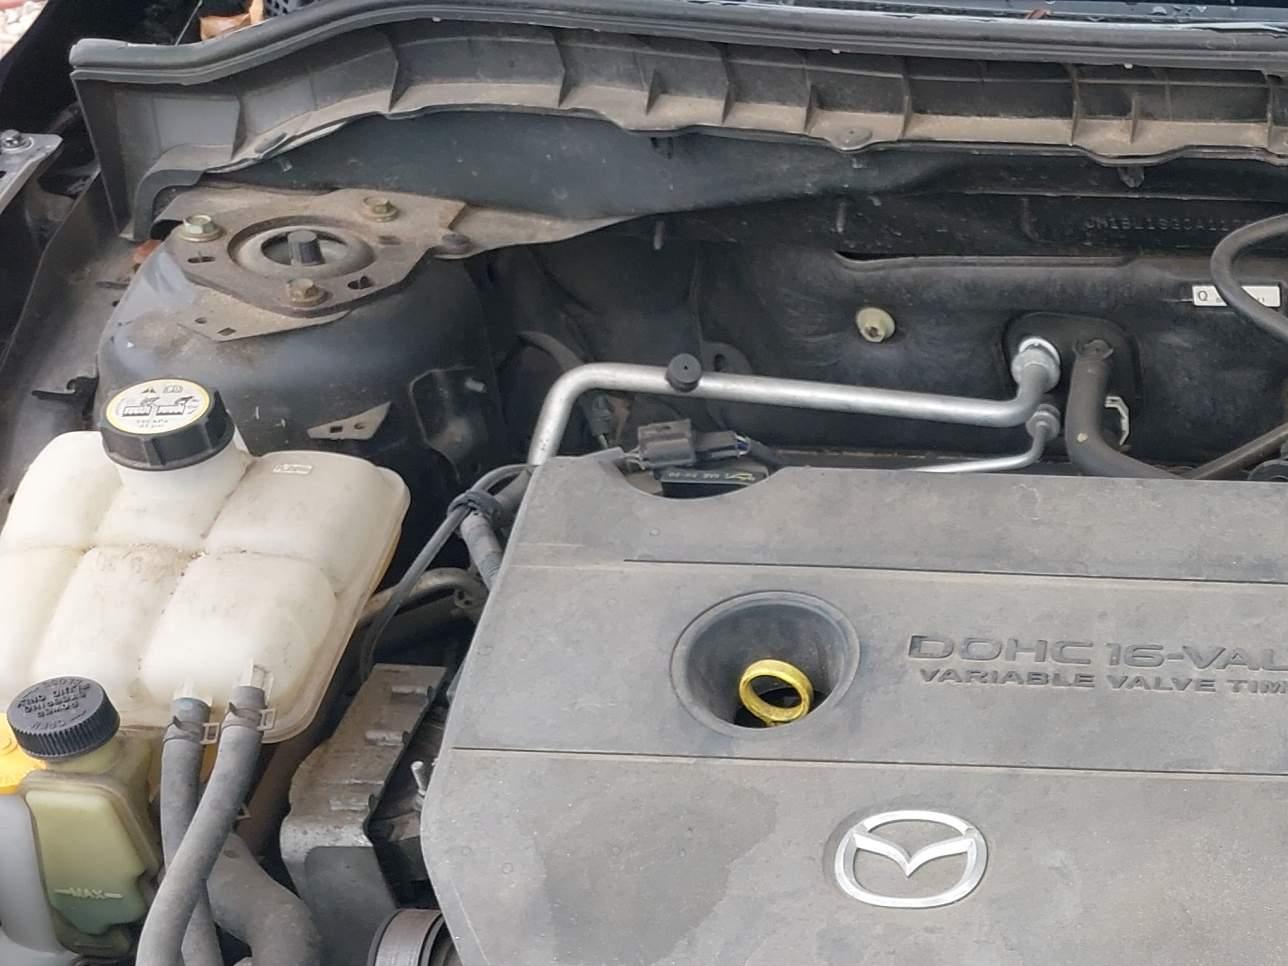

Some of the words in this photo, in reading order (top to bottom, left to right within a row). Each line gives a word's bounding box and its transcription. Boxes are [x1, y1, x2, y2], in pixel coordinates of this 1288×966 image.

[908, 634, 1094, 665] DOHC
[920, 668, 1096, 689] VARIABLE
[1107, 674, 1217, 693] VALVE
